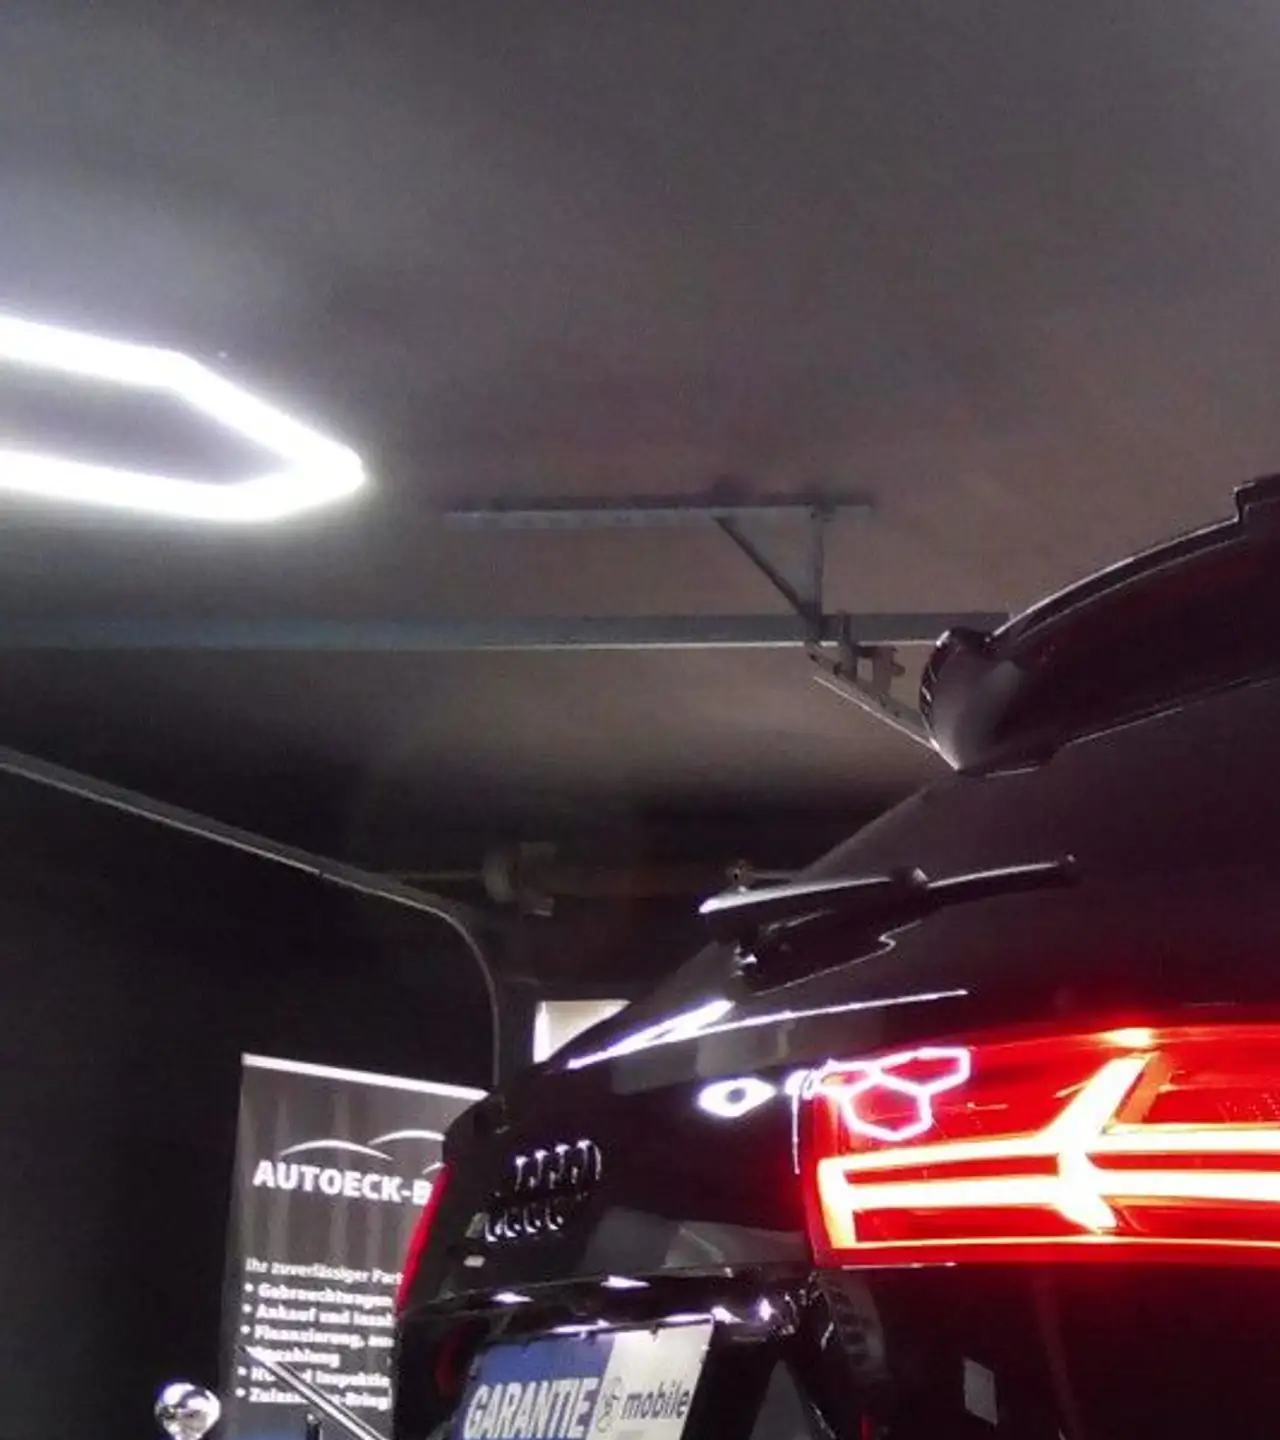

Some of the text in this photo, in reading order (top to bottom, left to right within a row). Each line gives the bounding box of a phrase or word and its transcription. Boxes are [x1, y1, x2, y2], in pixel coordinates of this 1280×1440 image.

[244, 1256, 270, 1273] Ihr
[256, 1303, 317, 1322] Ankauf
[319, 1309, 350, 1324] und
[463, 1377, 599, 1440] GARANTIE
[620, 1380, 690, 1419] mobile
